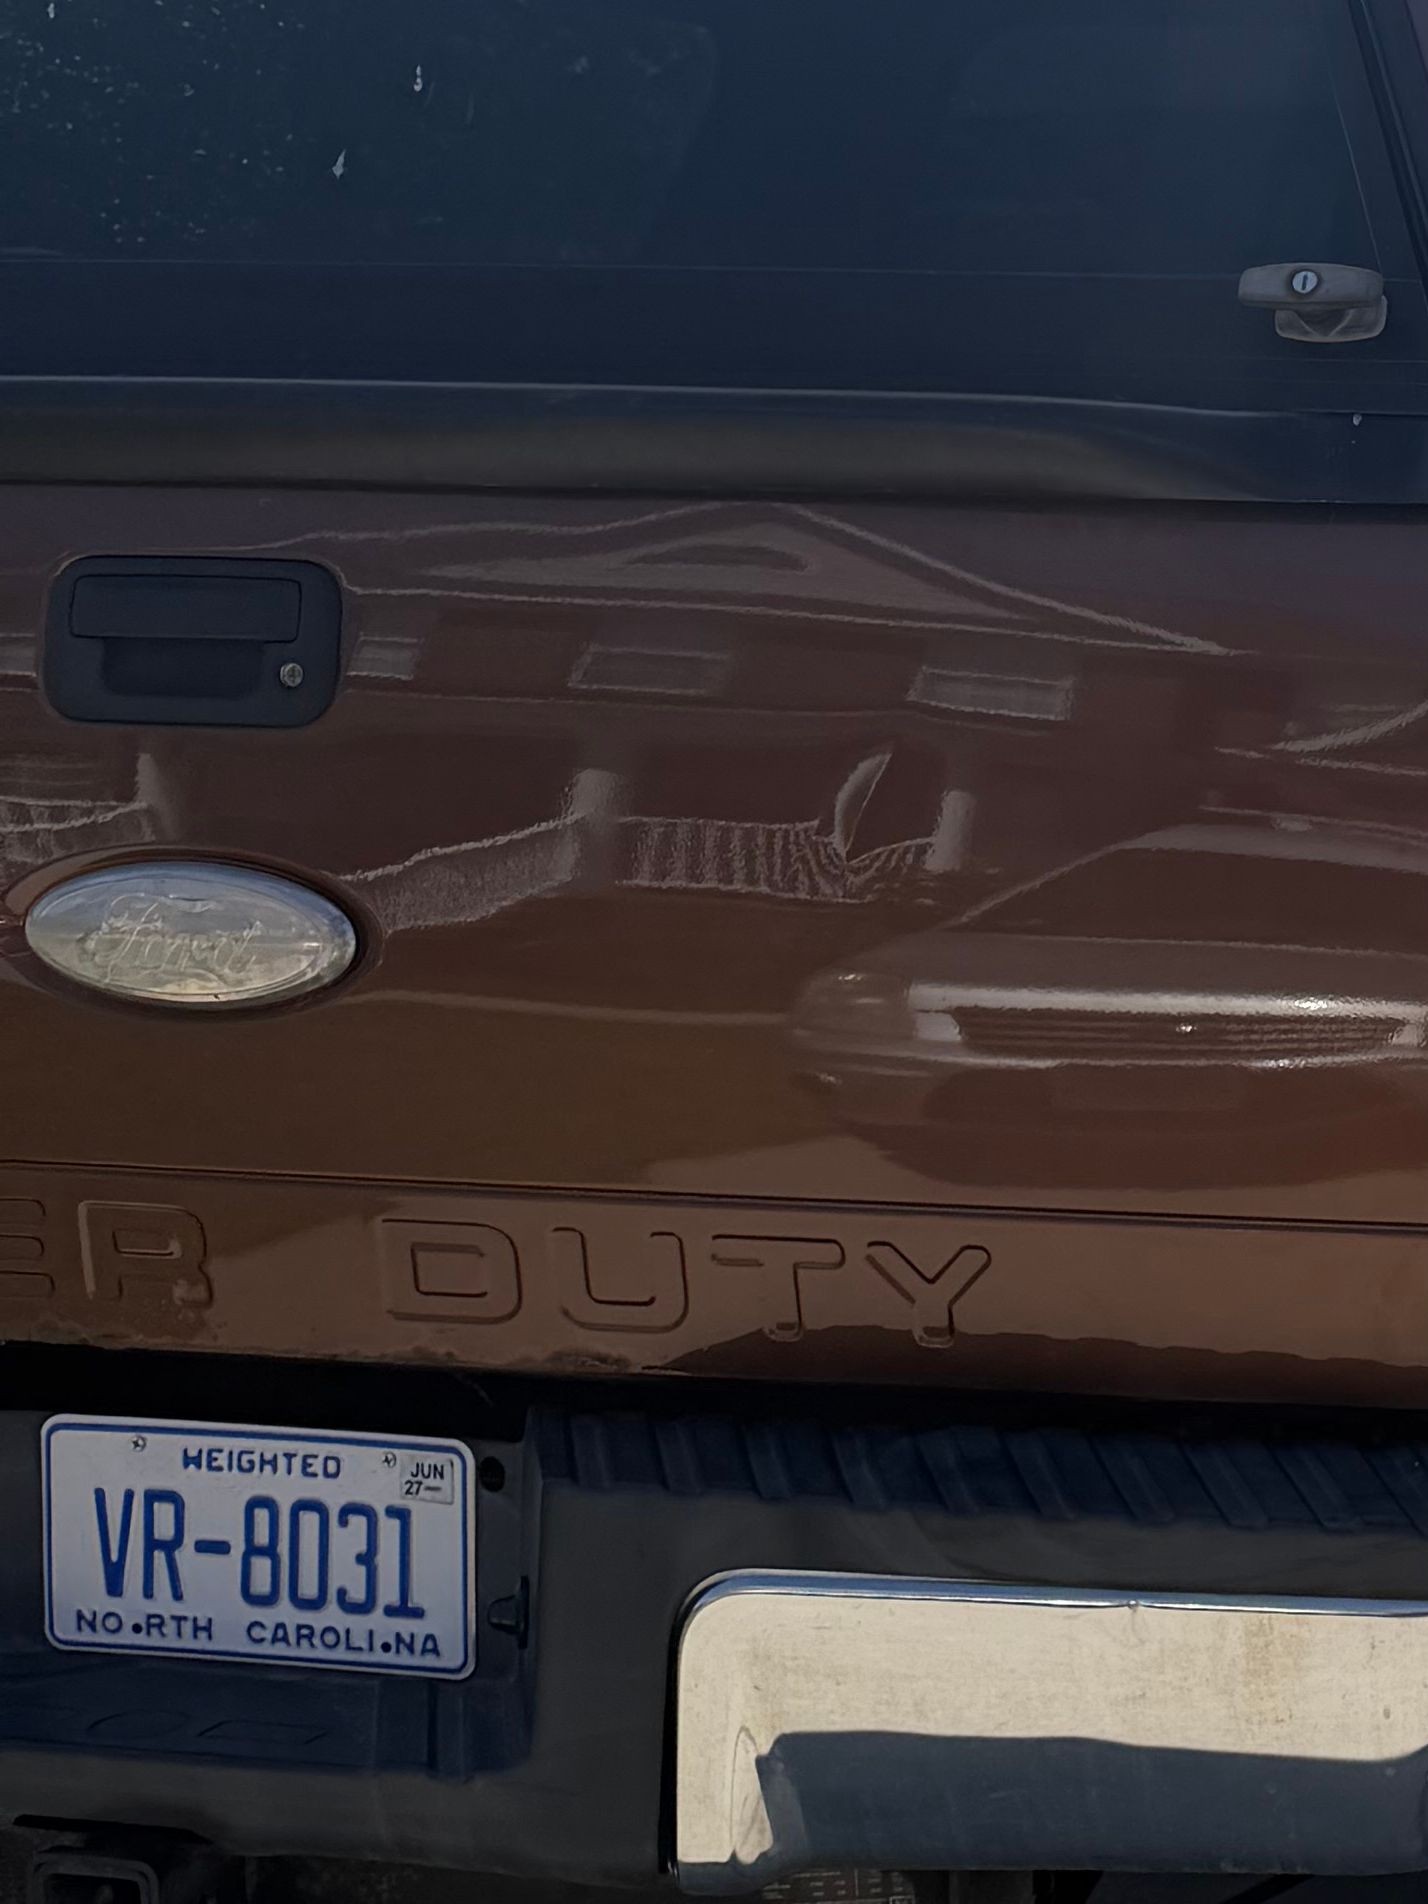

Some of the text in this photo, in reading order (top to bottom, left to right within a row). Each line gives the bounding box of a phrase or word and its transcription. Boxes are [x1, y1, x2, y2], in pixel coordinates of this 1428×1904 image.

[382, 1219, 992, 1348] DUTY
[182, 1448, 342, 1479] WEIGHTED
[410, 1462, 444, 1480] JUN
[94, 1487, 426, 1619] VR-8031
[76, 1610, 441, 1658] NORTH CAROLINA
